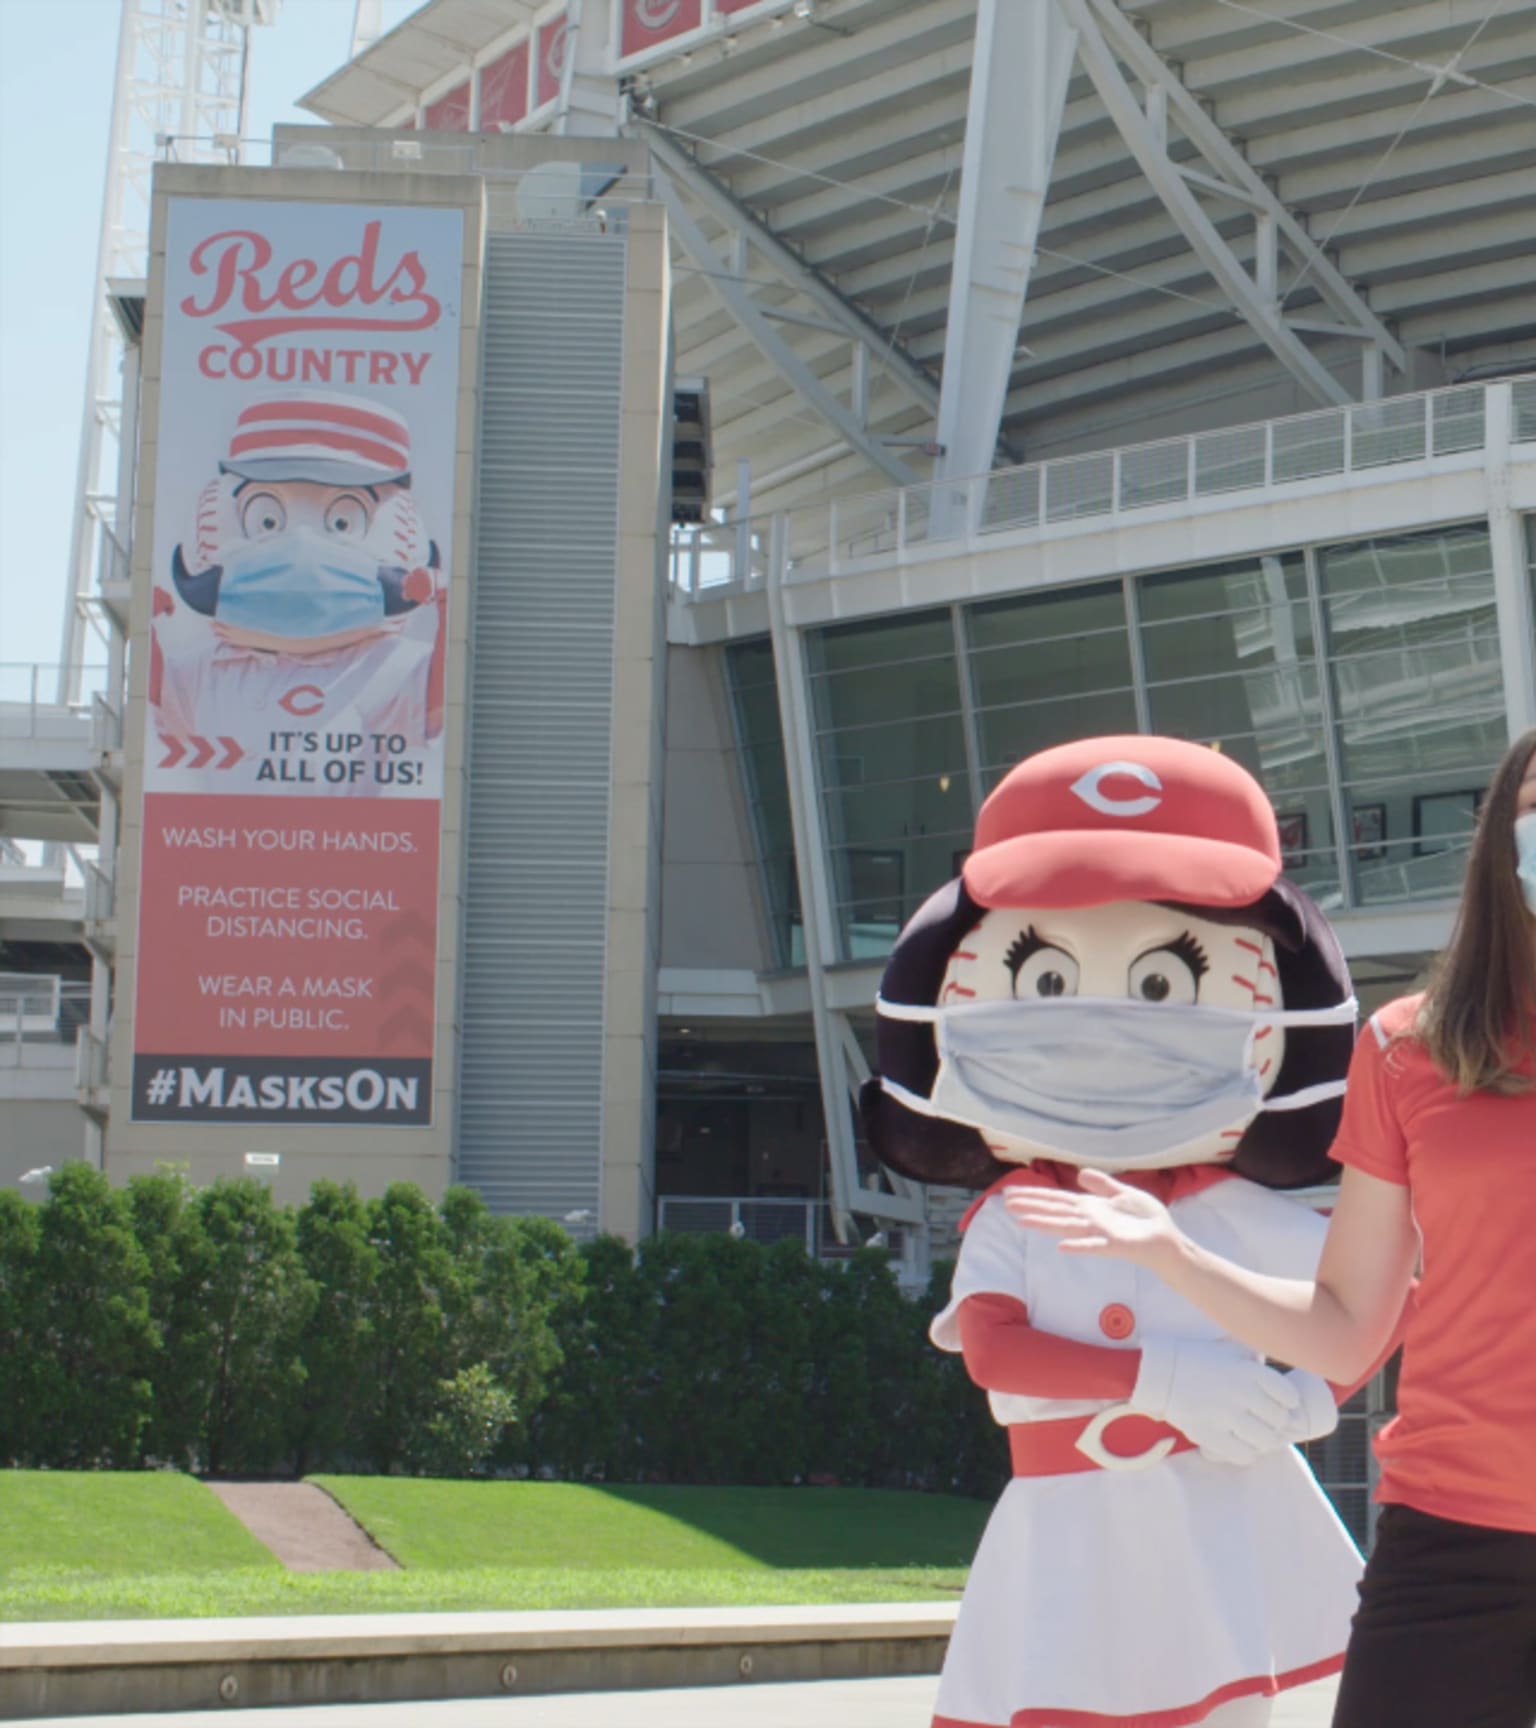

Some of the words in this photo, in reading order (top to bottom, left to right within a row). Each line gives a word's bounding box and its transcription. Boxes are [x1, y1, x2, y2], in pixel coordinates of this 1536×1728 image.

[180, 220, 441, 332] Reds
[198, 344, 432, 385] COUNTRY
[269, 731, 319, 753] IT'S
[325, 733, 363, 754] UP
[371, 734, 407, 755] TO
[256, 758, 315, 782] ALL
[323, 759, 365, 783] OF
[374, 761, 424, 785] US!
[162, 827, 236, 849] WASH
[243, 829, 315, 851] YOUR
[322, 831, 418, 853] HANDS.
[177, 885, 300, 909] PRACTICE
[307, 887, 400, 911] SOCIAL
[206, 916, 368, 940] DISTANCING.
[198, 975, 272, 997] WEAR
[277, 976, 296, 997] A
[301, 976, 373, 998] MASK
[219, 1007, 246, 1029] IN
[254, 1008, 350, 1030] PUBLIC.
